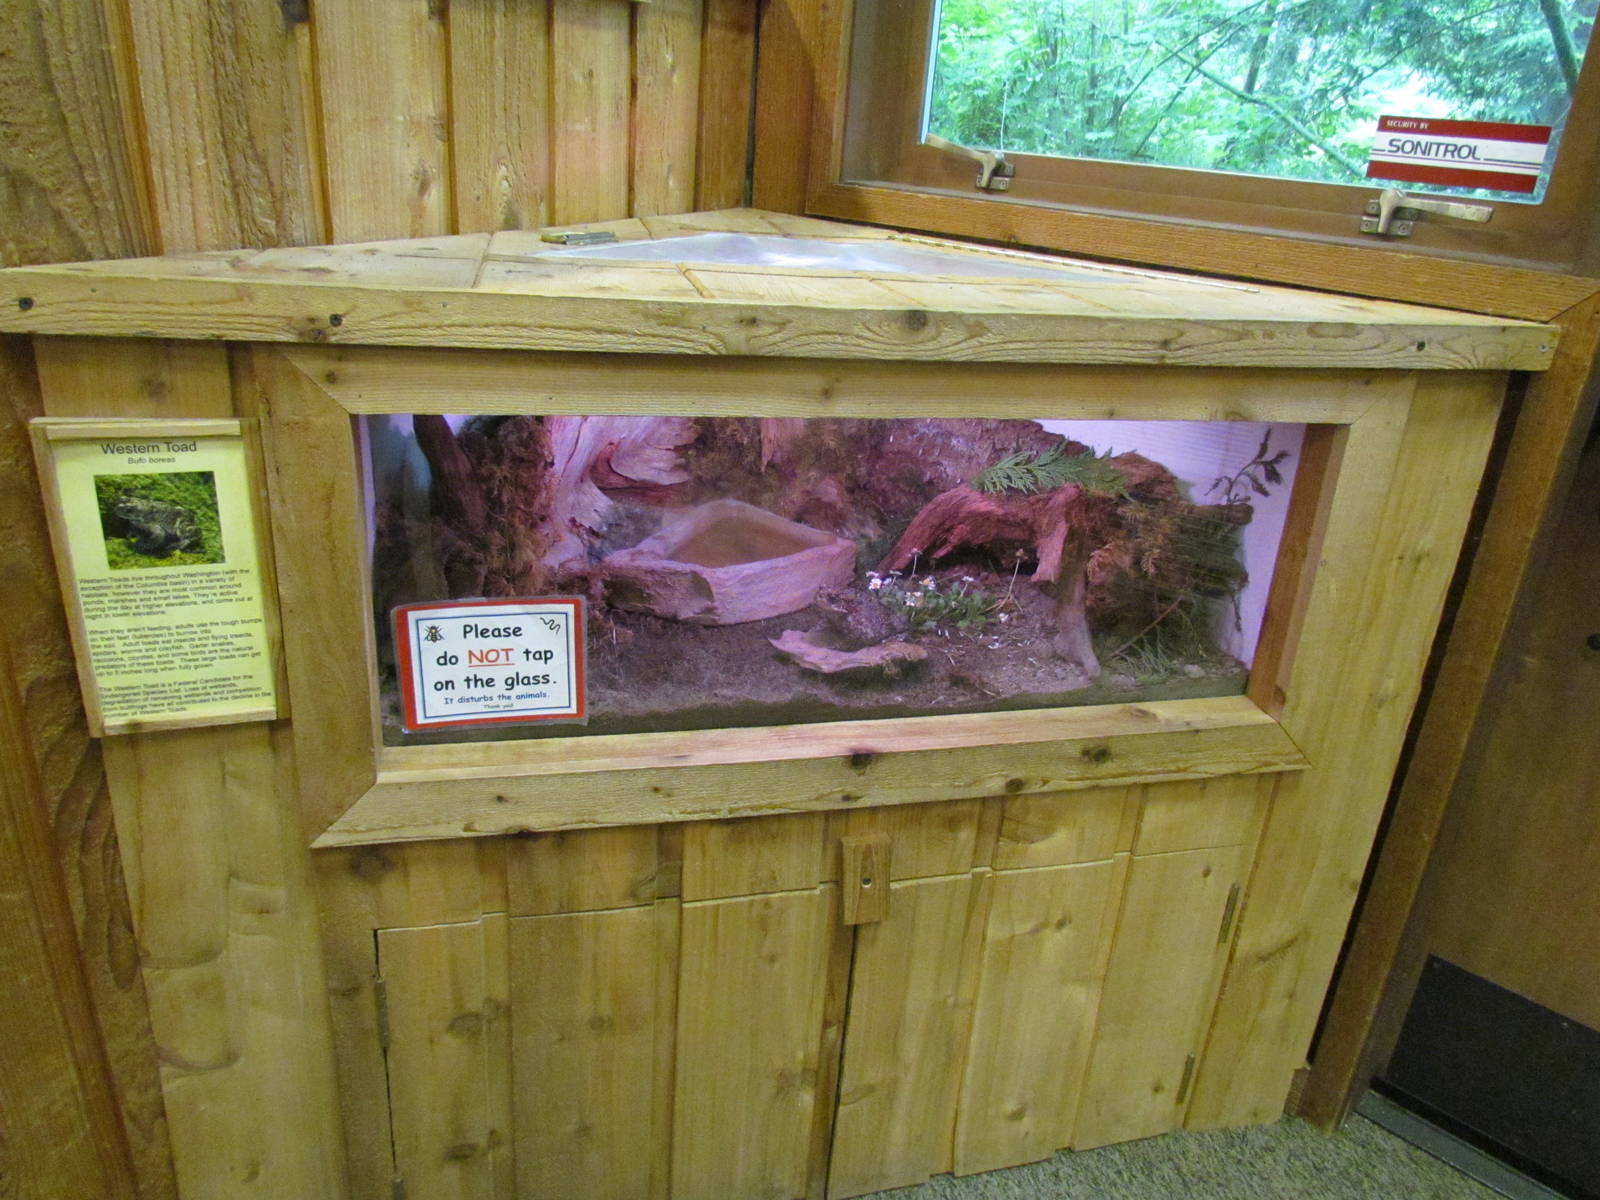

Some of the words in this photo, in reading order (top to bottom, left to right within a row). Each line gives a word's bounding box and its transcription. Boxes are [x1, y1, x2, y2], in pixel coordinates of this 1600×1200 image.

[1385, 119, 1417, 129] SECURITY
[1420, 122, 1429, 130] BY
[1387, 138, 1481, 161] SONITROL
[101, 442, 160, 454] Western
[163, 440, 197, 453] Toad
[149, 456, 176, 464] boreas
[463, 624, 523, 639] Please
[436, 651, 459, 666] do
[468, 648, 515, 665] NOT
[522, 647, 554, 665] tap
[434, 678, 455, 692] on
[463, 674, 496, 690] the
[504, 671, 557, 691] glass.
[444, 697, 454, 705] It
[457, 693, 494, 704] disturbs
[497, 693, 512, 701] the
[515, 691, 550, 701] animals.
